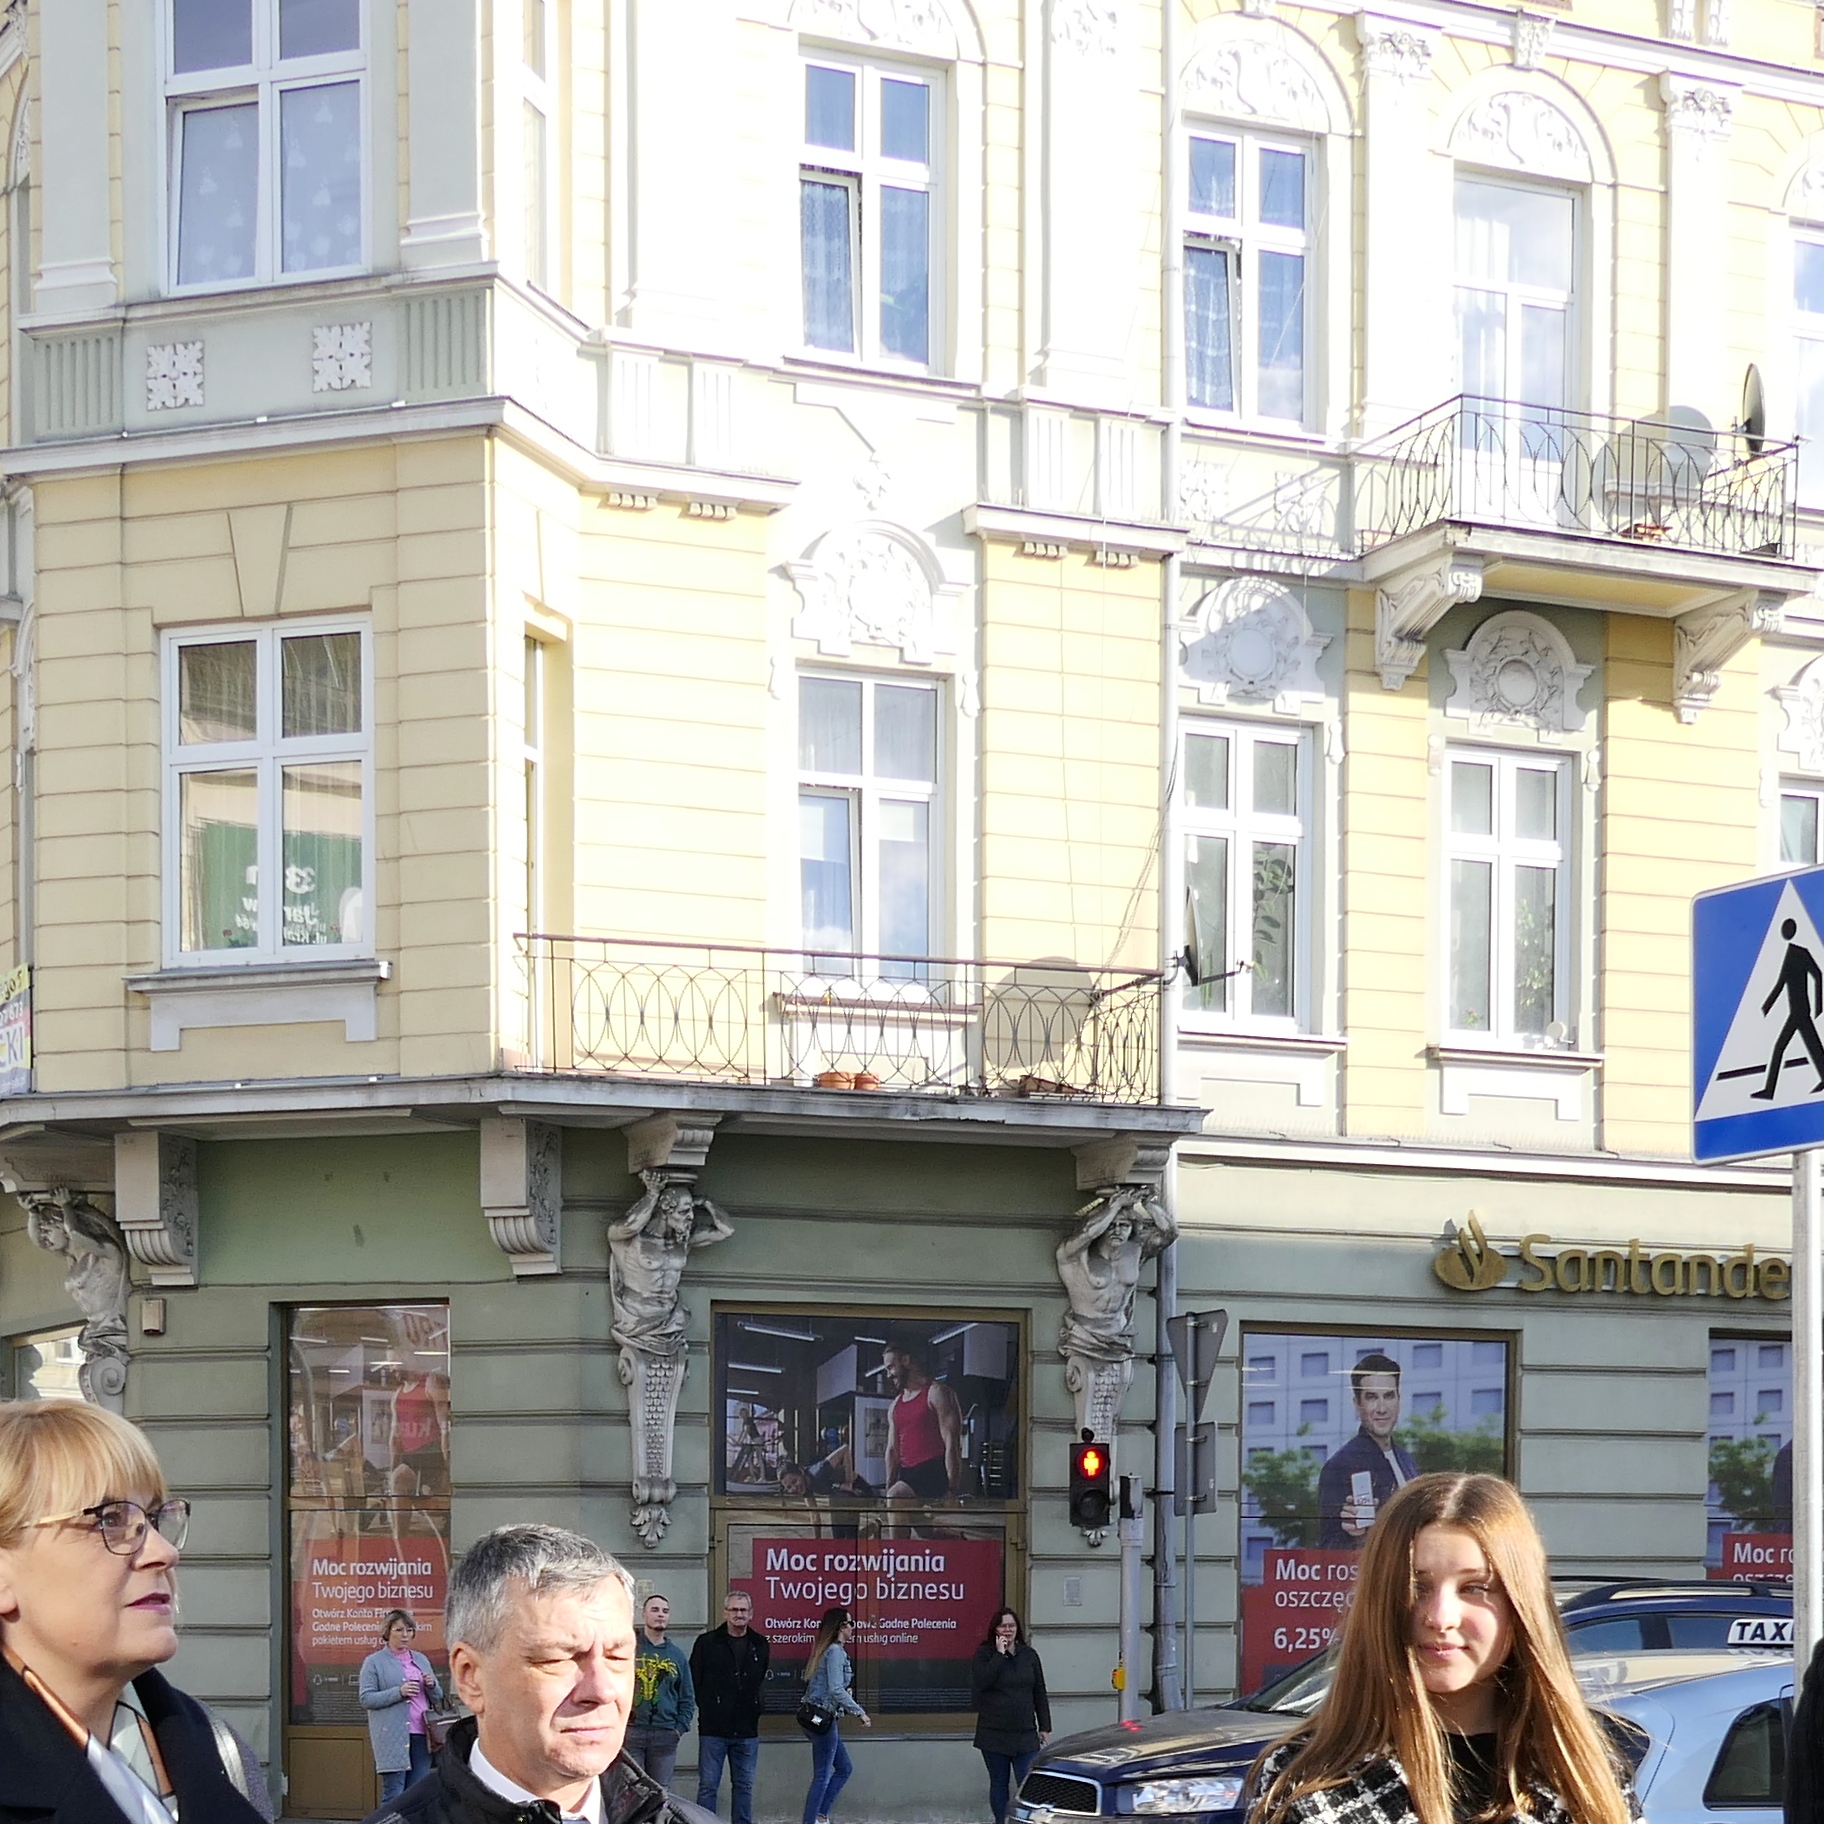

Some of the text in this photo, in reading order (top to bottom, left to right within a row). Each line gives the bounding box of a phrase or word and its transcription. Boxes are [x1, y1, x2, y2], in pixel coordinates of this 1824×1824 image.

[1518, 1233, 1790, 1300] Santande
[766, 1548, 945, 1578] Moc rozwijania
[1733, 1543, 1774, 1564] Moc
[312, 1558, 431, 1579] Moc rozwijania
[1276, 1559, 1321, 1581] Moc
[312, 1582, 433, 1603] Twojego biznesu
[765, 1577, 964, 1606] Twojego biznesu
[312, 1608, 346, 1618] Otwórz
[347, 1609, 373, 1618] Konto
[765, 1617, 802, 1629] Otwórz
[911, 1617, 957, 1629] Polecenia
[312, 1621, 381, 1632] Godne Poleceni
[312, 1635, 353, 1646] pakietem
[772, 1633, 815, 1644] szerokim
[889, 1632, 918, 1644] online
